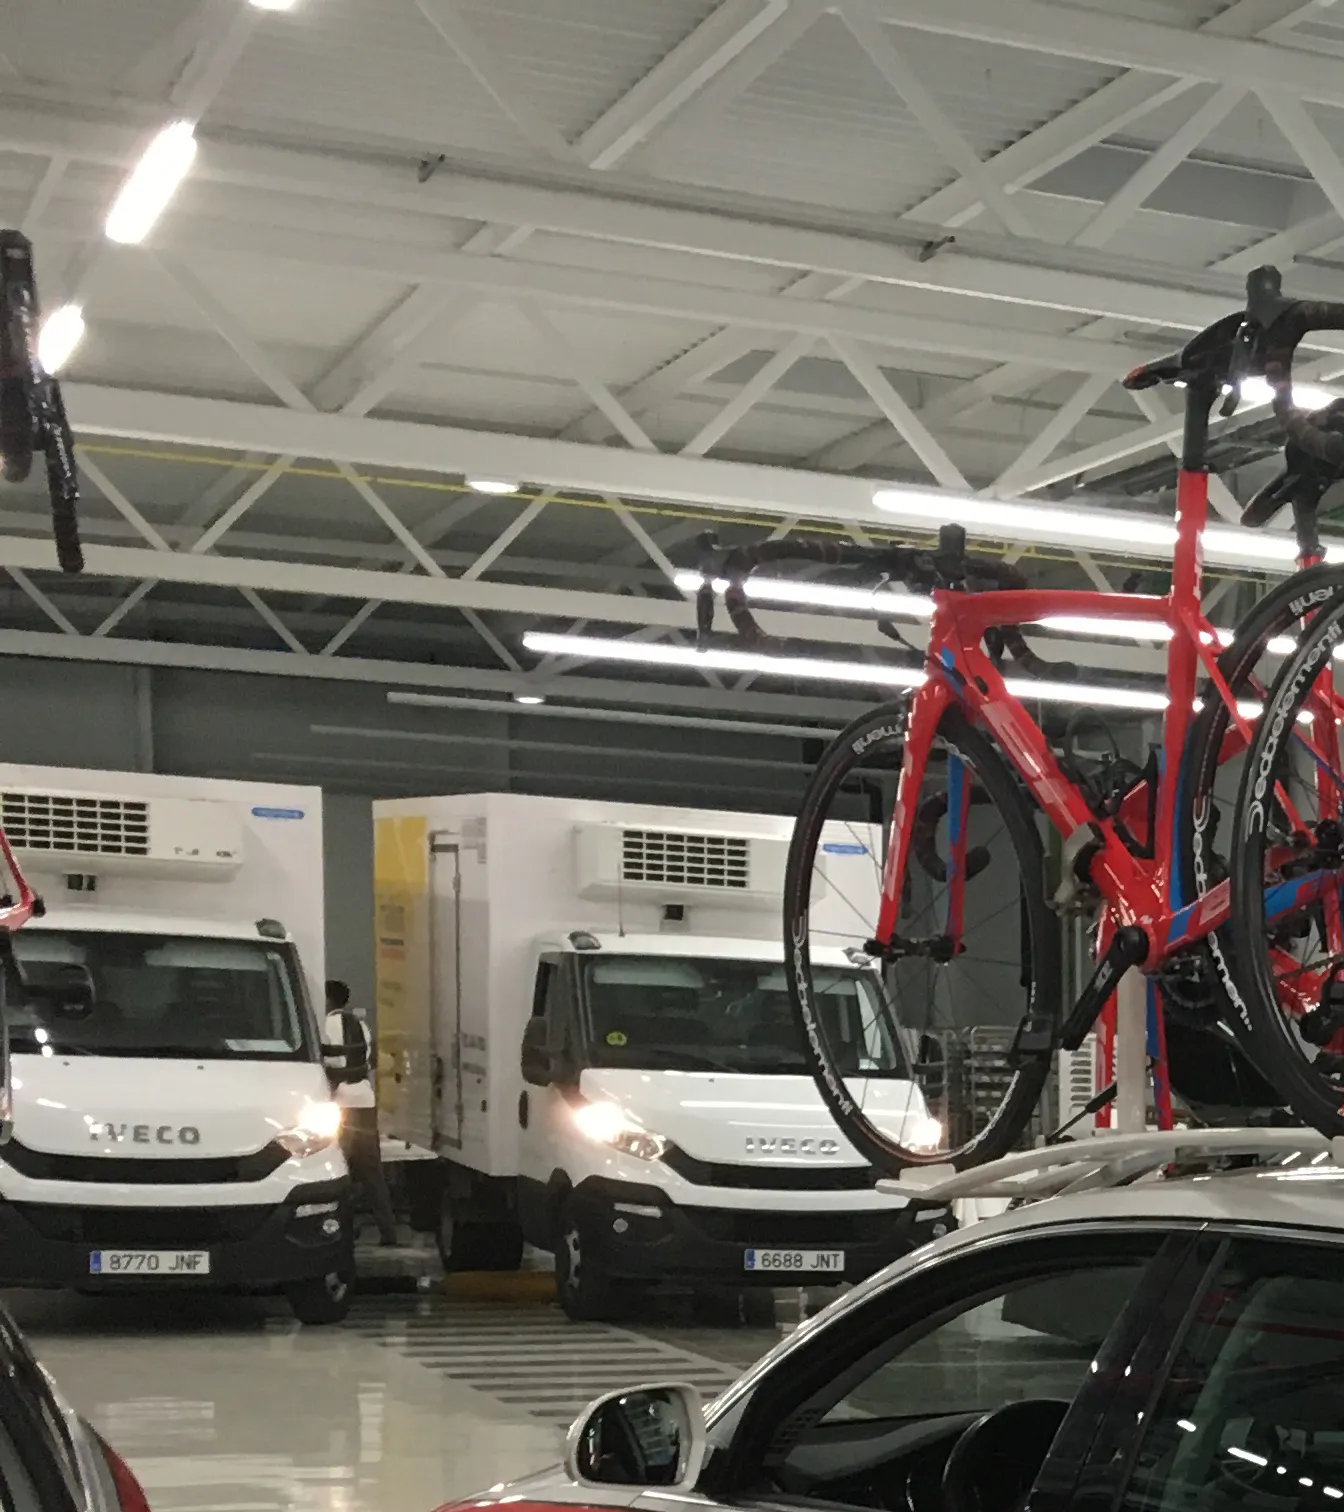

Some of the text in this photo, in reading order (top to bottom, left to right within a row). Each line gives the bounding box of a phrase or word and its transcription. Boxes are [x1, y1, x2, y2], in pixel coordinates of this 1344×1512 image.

[745, 1136, 841, 1156] IVECO
[109, 1254, 160, 1271] 8770
[761, 1250, 840, 1269] 6688 JNT
